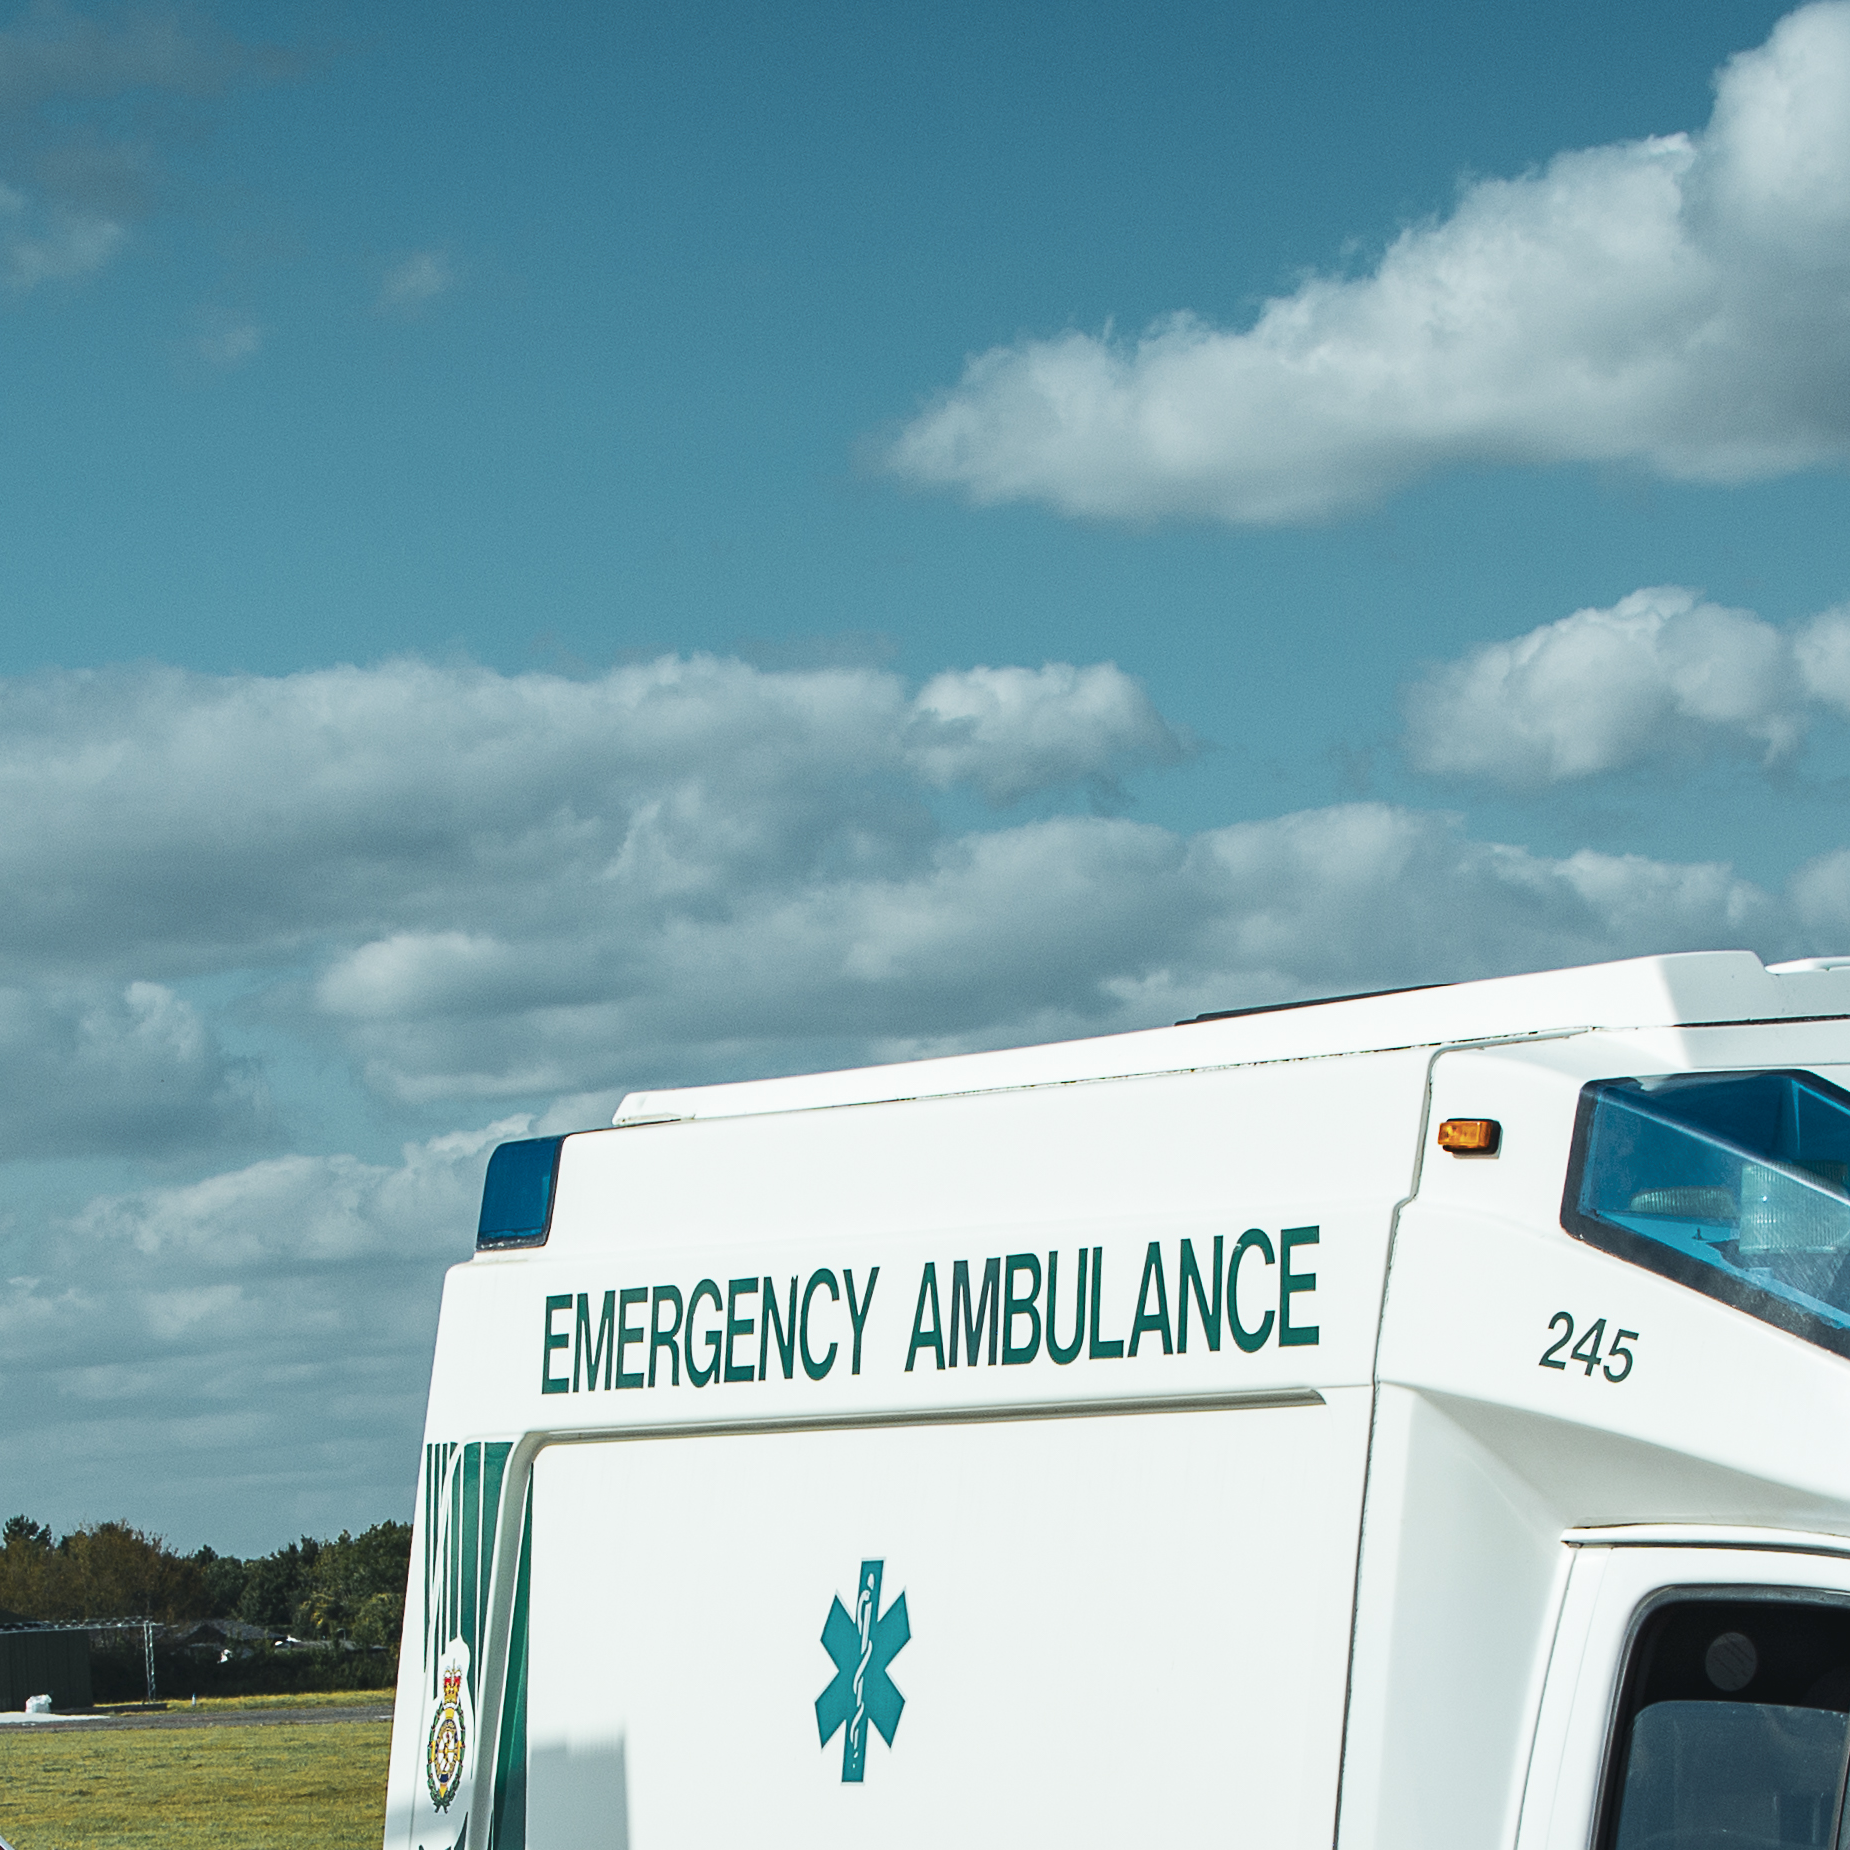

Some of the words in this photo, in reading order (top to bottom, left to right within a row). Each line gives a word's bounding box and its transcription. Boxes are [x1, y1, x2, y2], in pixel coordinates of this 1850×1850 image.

[541, 1264, 880, 1396] EMERGENCY
[904, 1224, 1320, 1372] AMBULANCE
[1538, 1311, 1640, 1383] 245
